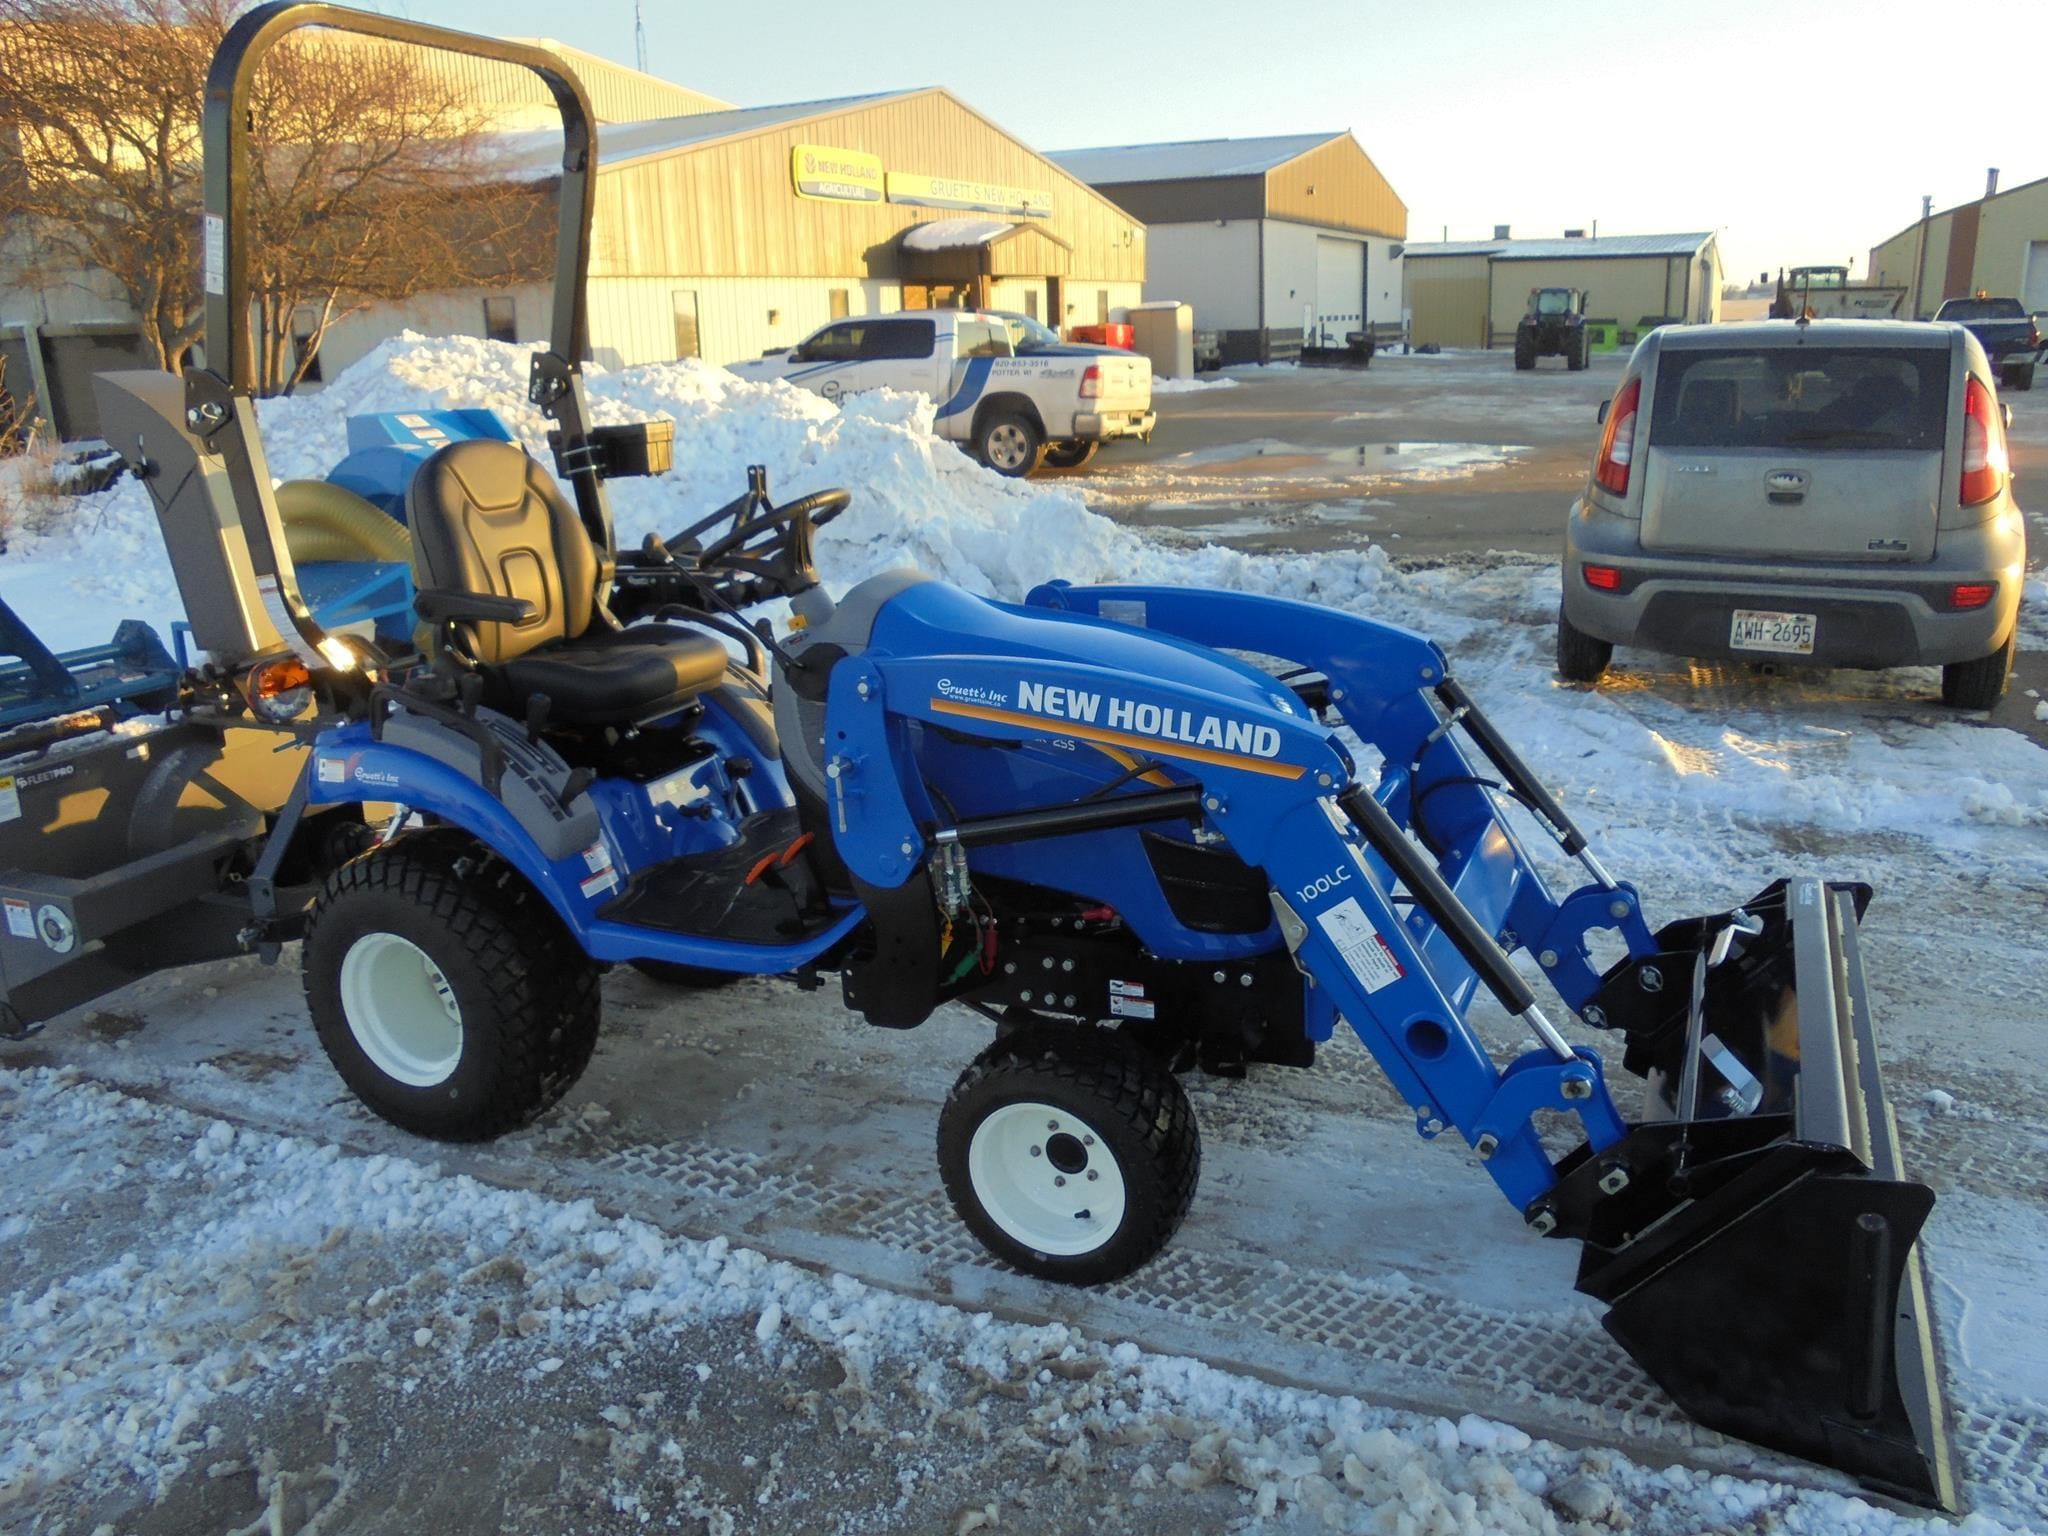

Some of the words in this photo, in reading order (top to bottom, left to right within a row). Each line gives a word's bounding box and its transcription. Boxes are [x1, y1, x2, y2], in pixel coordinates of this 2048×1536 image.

[818, 160, 838, 174] NEW
[840, 164, 878, 180] HOLLAND
[818, 182, 867, 199] AGRICULTURE
[984, 187, 1006, 204] NEW
[1735, 621, 1811, 643] AWH-2695
[937, 678, 986, 699] Gruett's
[988, 689, 1009, 703] Inc
[1017, 680, 1101, 722] NEW
[1108, 697, 1281, 758] HOLLAND
[27, 765, 75, 786] FLEETPRO
[1296, 865, 1352, 903] 100LC
